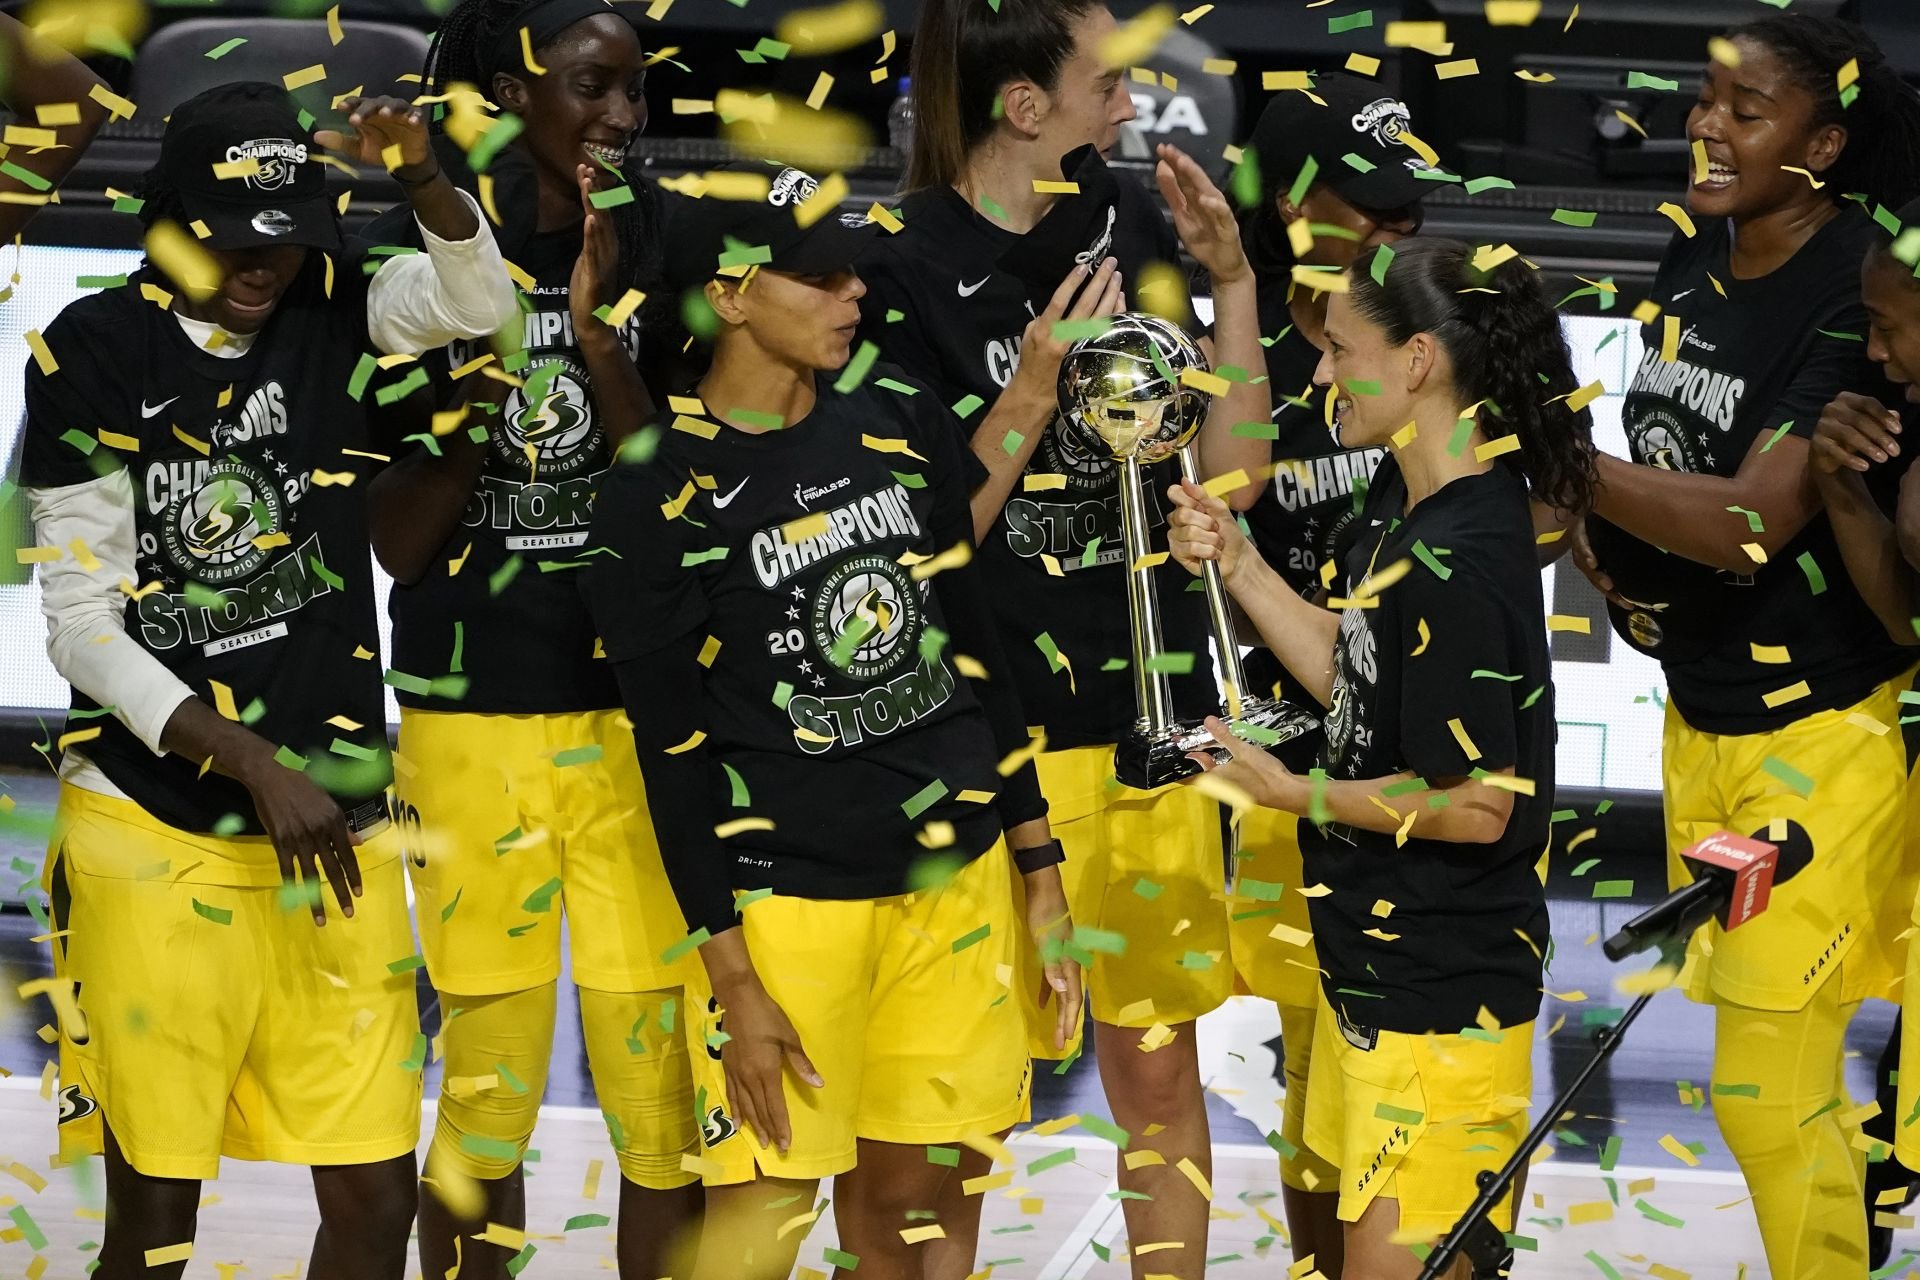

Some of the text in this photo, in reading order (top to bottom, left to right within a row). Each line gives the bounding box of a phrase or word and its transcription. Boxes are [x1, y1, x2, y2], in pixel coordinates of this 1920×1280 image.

[226, 144, 307, 164] CHAMPIONS
[515, 453, 585, 473] CHMPIONS
[1069, 465, 1119, 489] CHAMPION
[207, 463, 255, 480] ASKETBALL
[256, 477, 278, 534] ASSOCIATIO
[522, 536, 575, 547] SEATTLE
[843, 559, 897, 575] BASKETBALL
[1288, 547, 1316, 572] 20
[138, 532, 331, 649] STORM
[816, 570, 843, 617] NATIONAL
[895, 574, 916, 641] ASSOCIATION
[220, 629, 272, 650] SEATTLE
[767, 629, 805, 655] 20
[816, 622, 840, 667] OMEN'S
[847, 647, 905, 677] CHAMPIONS
[788, 650, 956, 755] STORM
[737, 855, 773, 869] DRI-FIT
[1804, 922, 1851, 985] SEATTLE
[1358, 1126, 1402, 1192] SEATTLE
